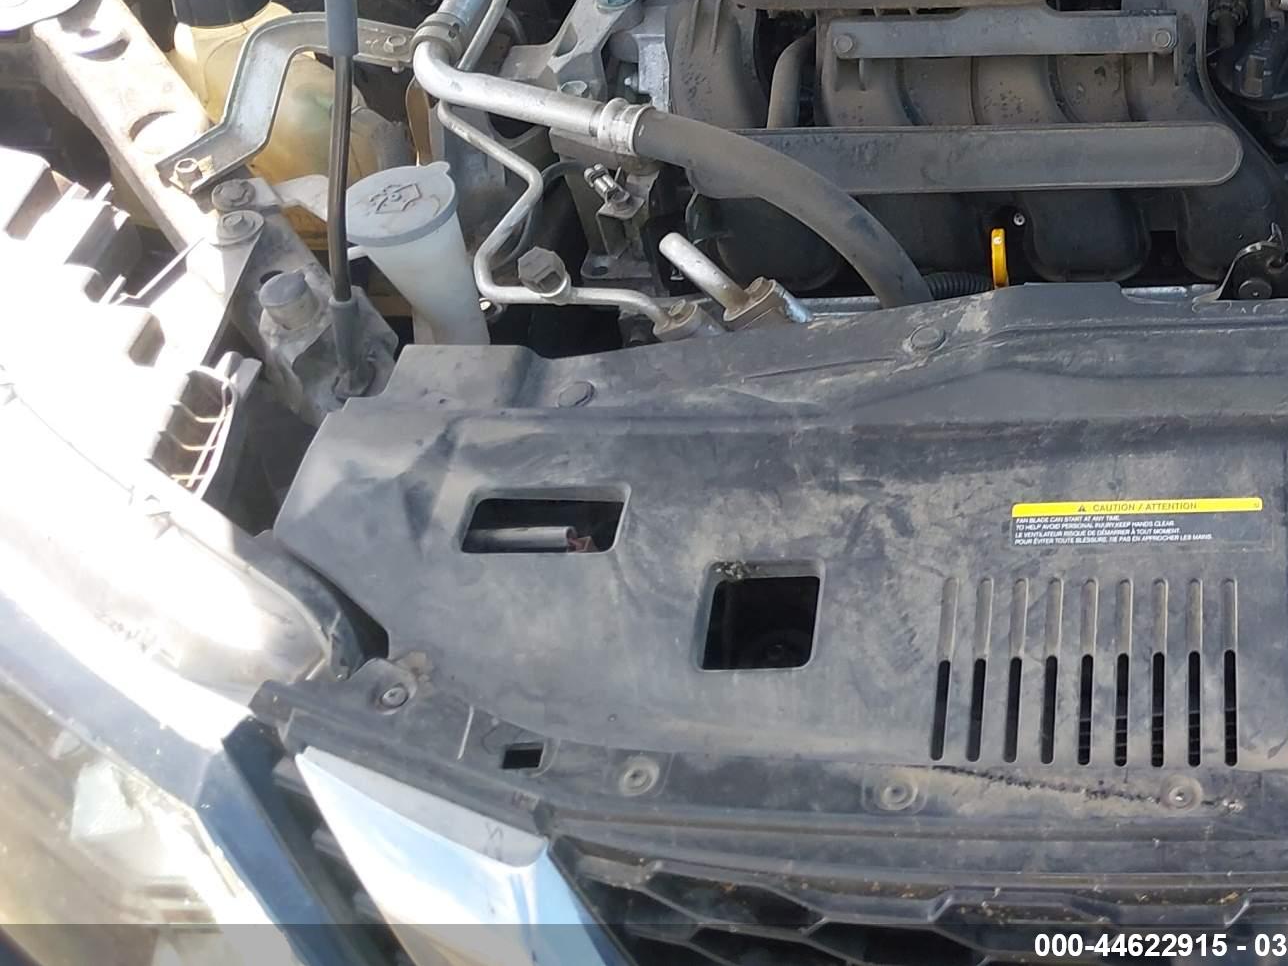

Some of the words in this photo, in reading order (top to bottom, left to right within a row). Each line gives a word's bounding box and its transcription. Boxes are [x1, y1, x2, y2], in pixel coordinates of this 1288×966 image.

[1093, 503, 1134, 511] CAUTION
[1146, 501, 1196, 510] ATTENTION
[1097, 528, 1130, 536] DÉMARRER
